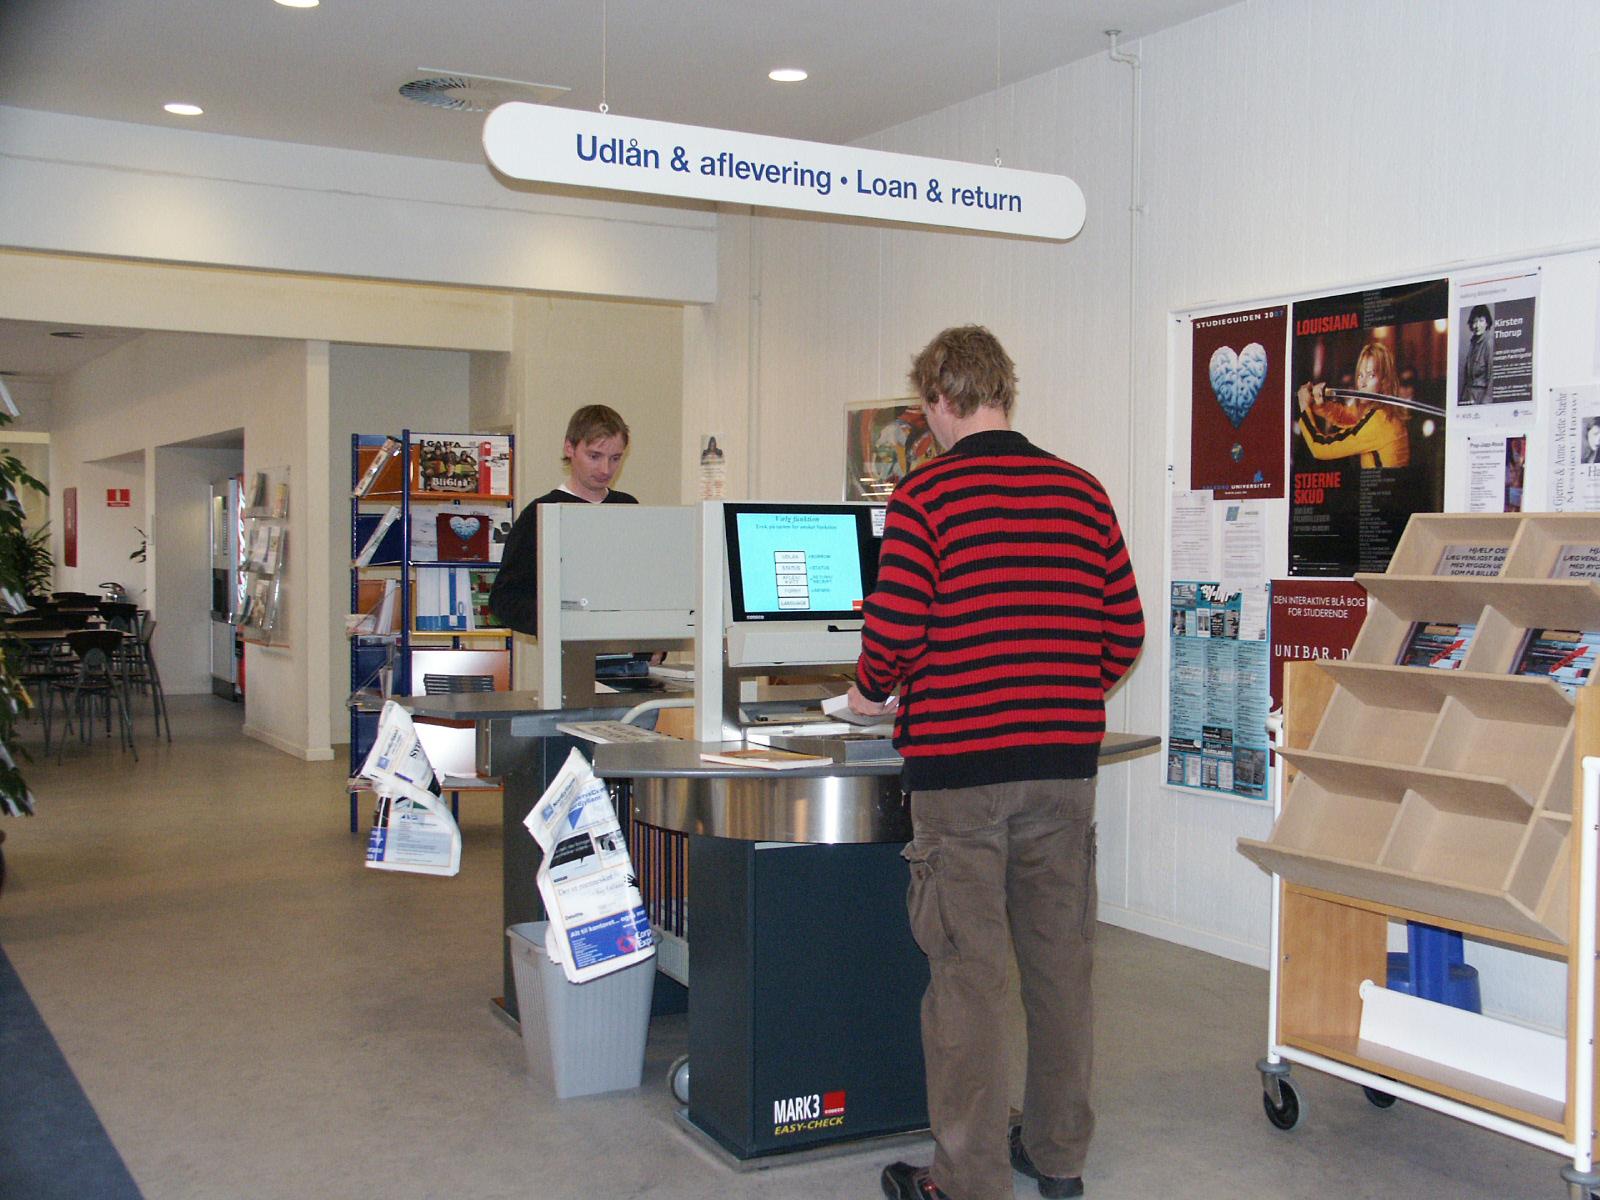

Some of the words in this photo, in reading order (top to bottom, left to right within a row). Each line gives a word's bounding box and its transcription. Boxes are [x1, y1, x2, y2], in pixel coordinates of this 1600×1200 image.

[576, 133, 660, 171] Udlån
[670, 145, 690, 173] &
[699, 151, 832, 196] aflevering
[856, 169, 918, 201] Loan
[926, 178, 943, 204] &
[951, 184, 1022, 214] return
[1196, 313, 1262, 329] STUDIEGUIDEN
[1296, 312, 1358, 336] LOUISIANA
[1494, 317, 1524, 327] Kirsten
[1494, 329, 1522, 338] Thorup
[1554, 444, 1566, 466] Anne
[1295, 471, 1342, 489] STJERNE
[1295, 488, 1325, 505] SKUD
[1273, 595, 1288, 604] DEN
[1288, 596, 1331, 606] INTERAKTIVE
[1331, 595, 1346, 606] BLÅ
[1347, 597, 1366, 607] BOG
[1288, 607, 1302, 616] FOR
[1303, 608, 1349, 619] STUDERENDE
[774, 1116, 845, 1136] EASY-CHECK
